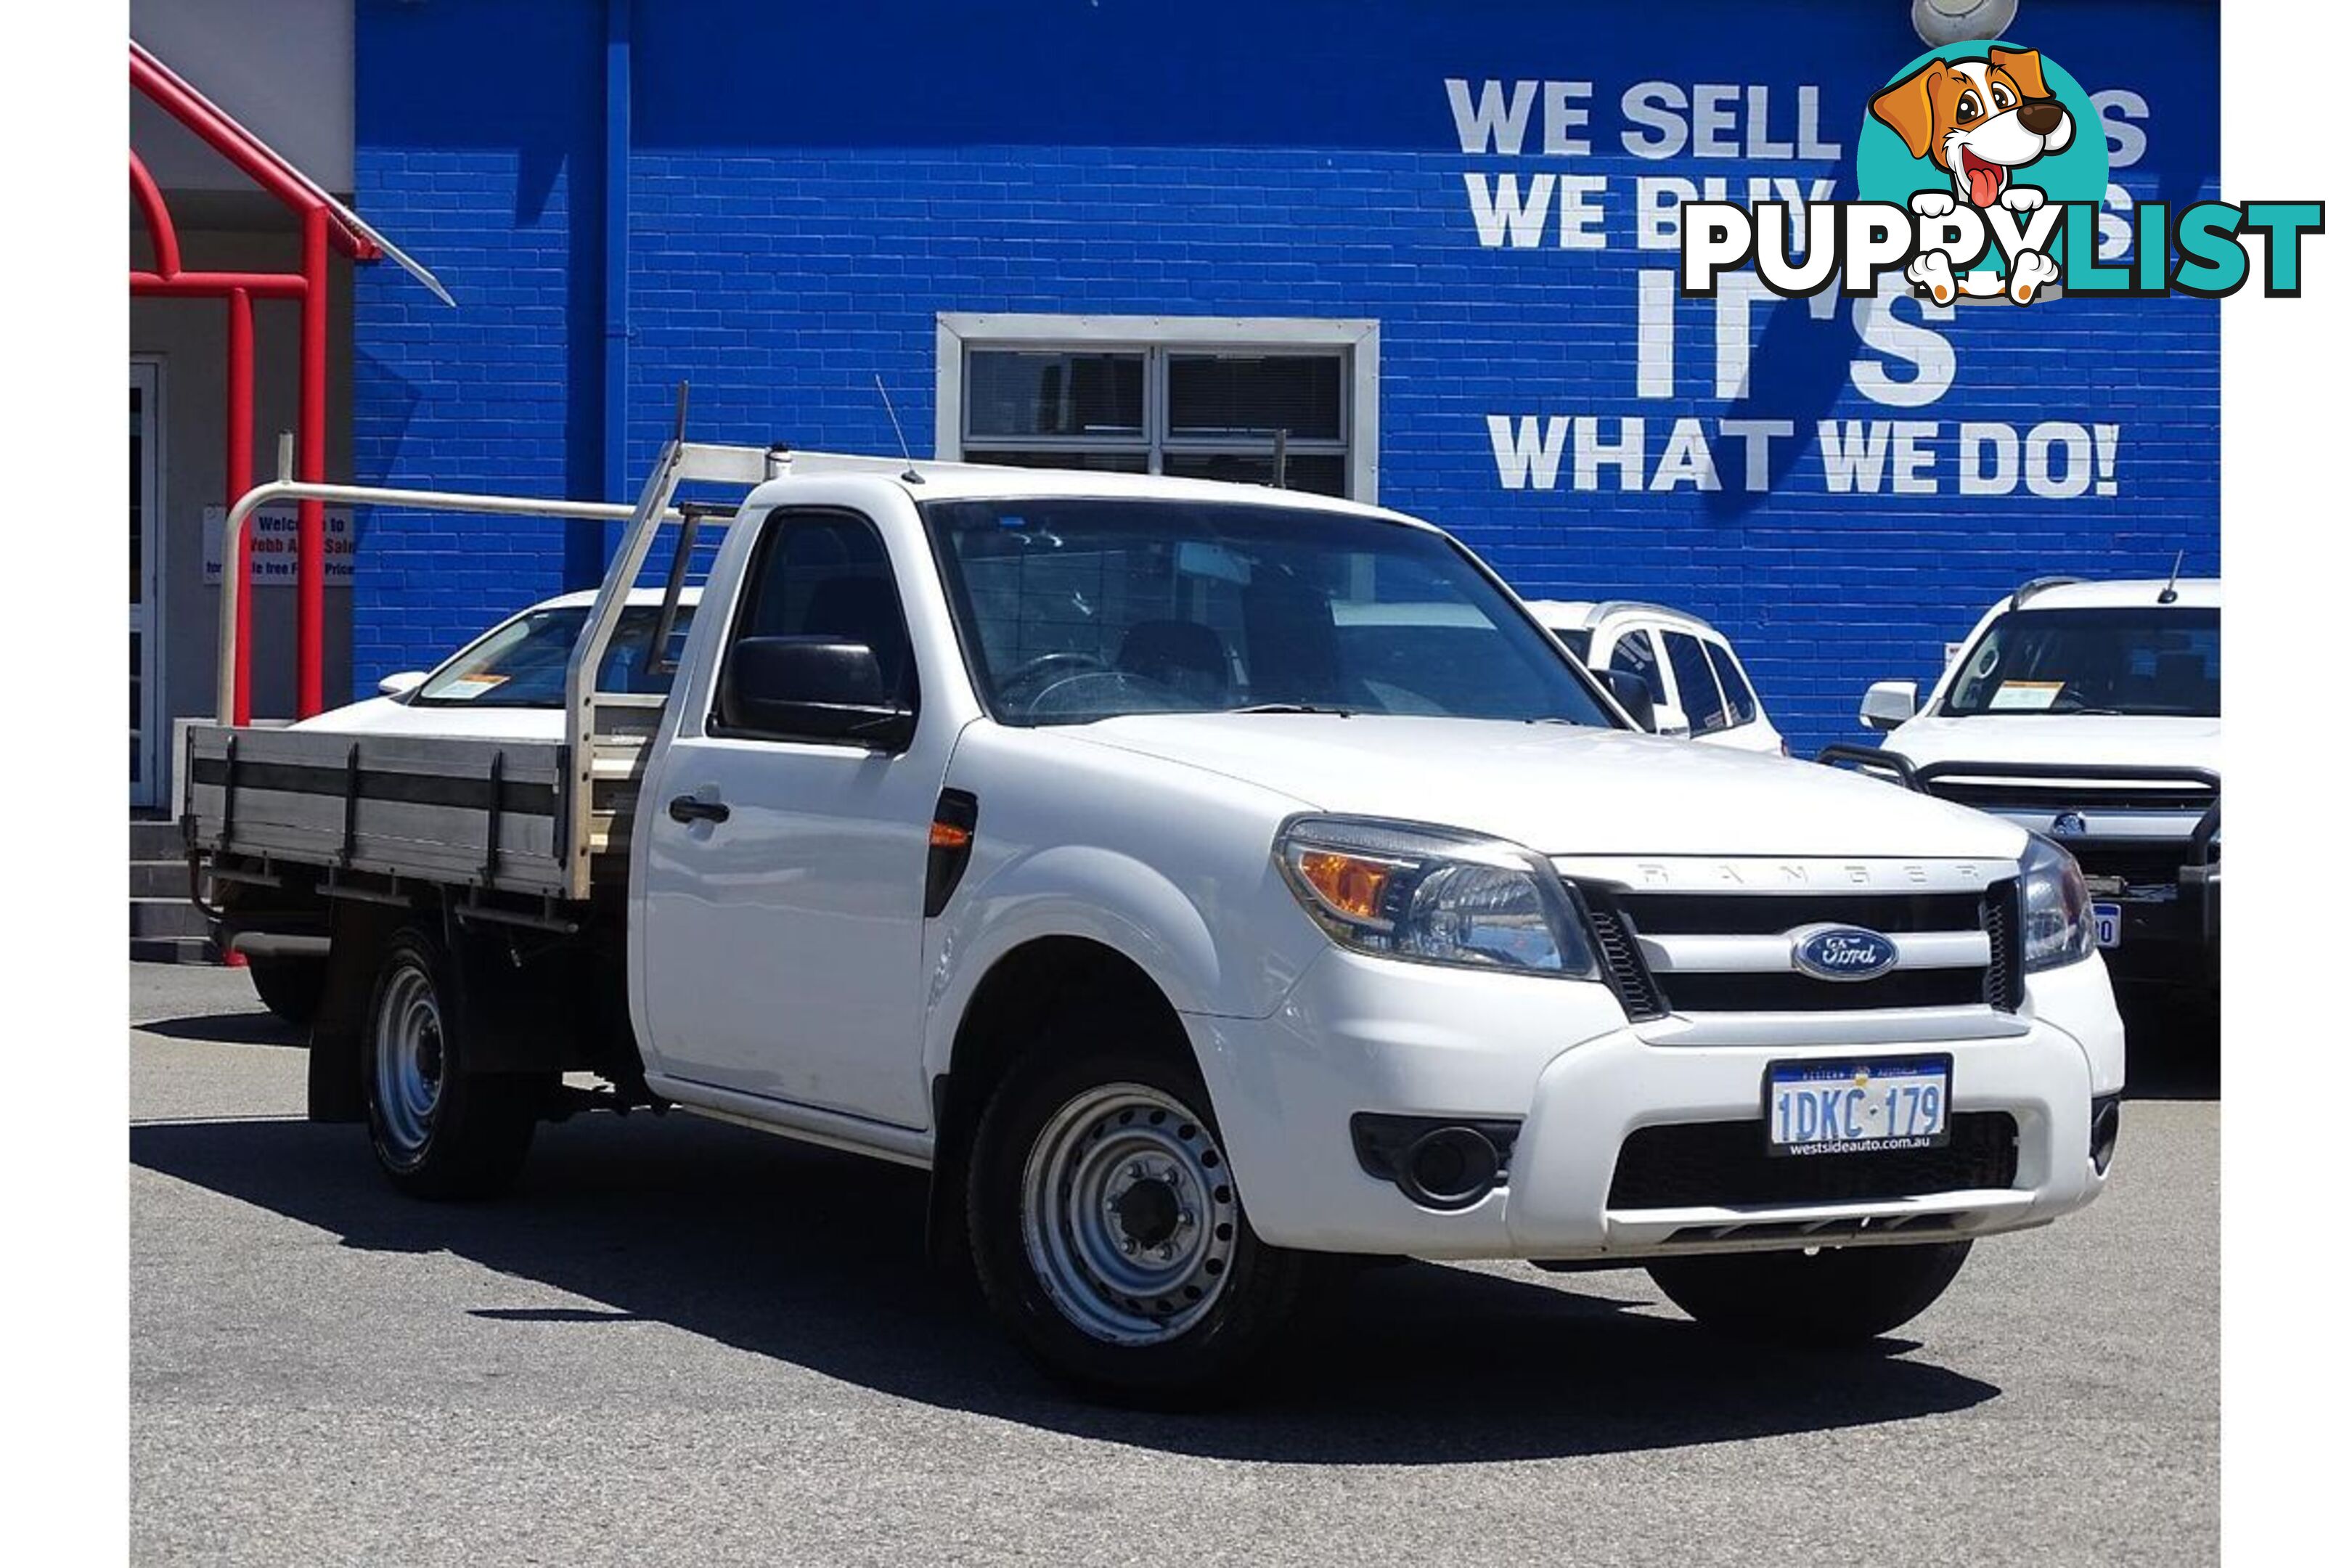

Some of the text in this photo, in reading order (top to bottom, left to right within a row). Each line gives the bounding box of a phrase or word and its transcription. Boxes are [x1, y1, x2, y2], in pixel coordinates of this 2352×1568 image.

[1444, 78, 1842, 160] WE SELL
[1463, 173, 1607, 248] WE
[1486, 415, 2120, 499] WHAT WE DO!
[258, 516, 345, 532] Welc to
[1822, 938, 1877, 964] Ford
[1779, 1085, 1940, 1142] 1DKC 179
[1789, 1136, 1930, 1156] westsideauto.com.au
